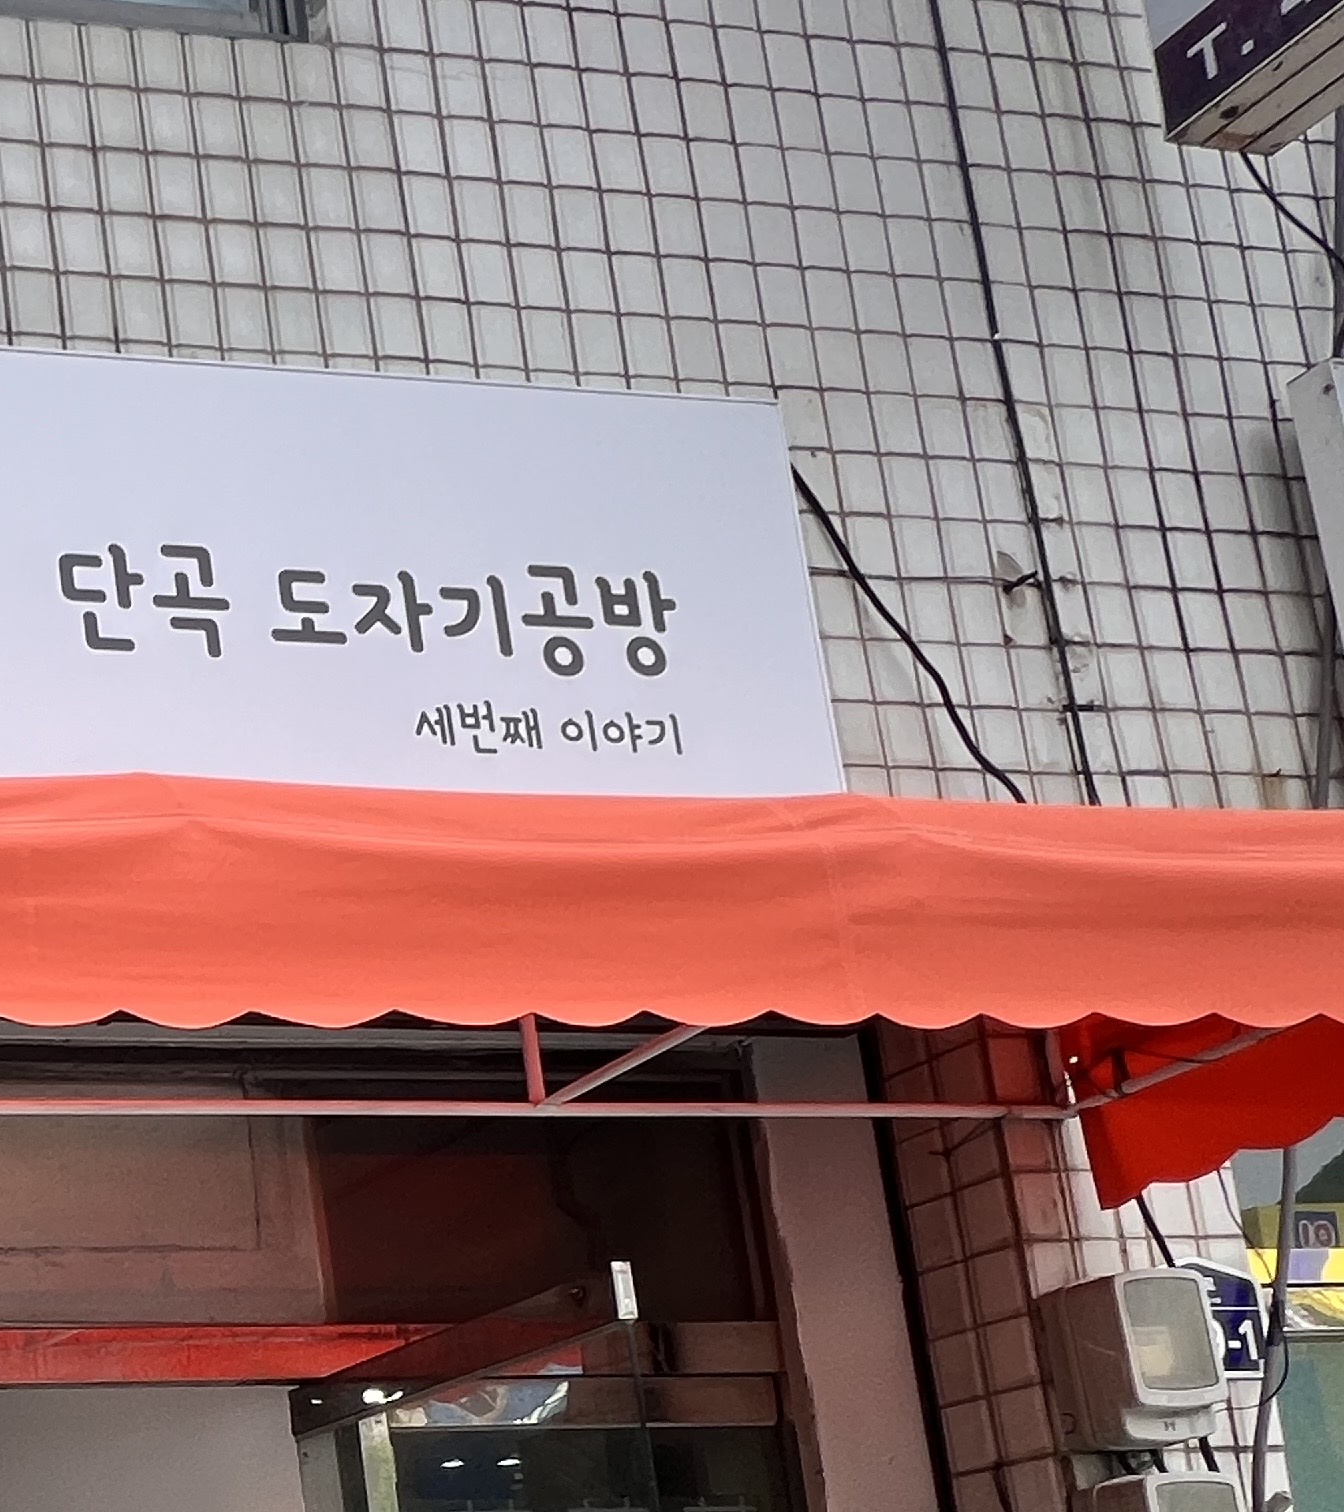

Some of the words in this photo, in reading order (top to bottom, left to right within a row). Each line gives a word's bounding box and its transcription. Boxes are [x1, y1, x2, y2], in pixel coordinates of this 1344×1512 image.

[59, 542, 231, 659] 단곡
[271, 563, 677, 678] 도자기공방
[415, 699, 543, 755] 세번째
[560, 709, 684, 756] 이야기
